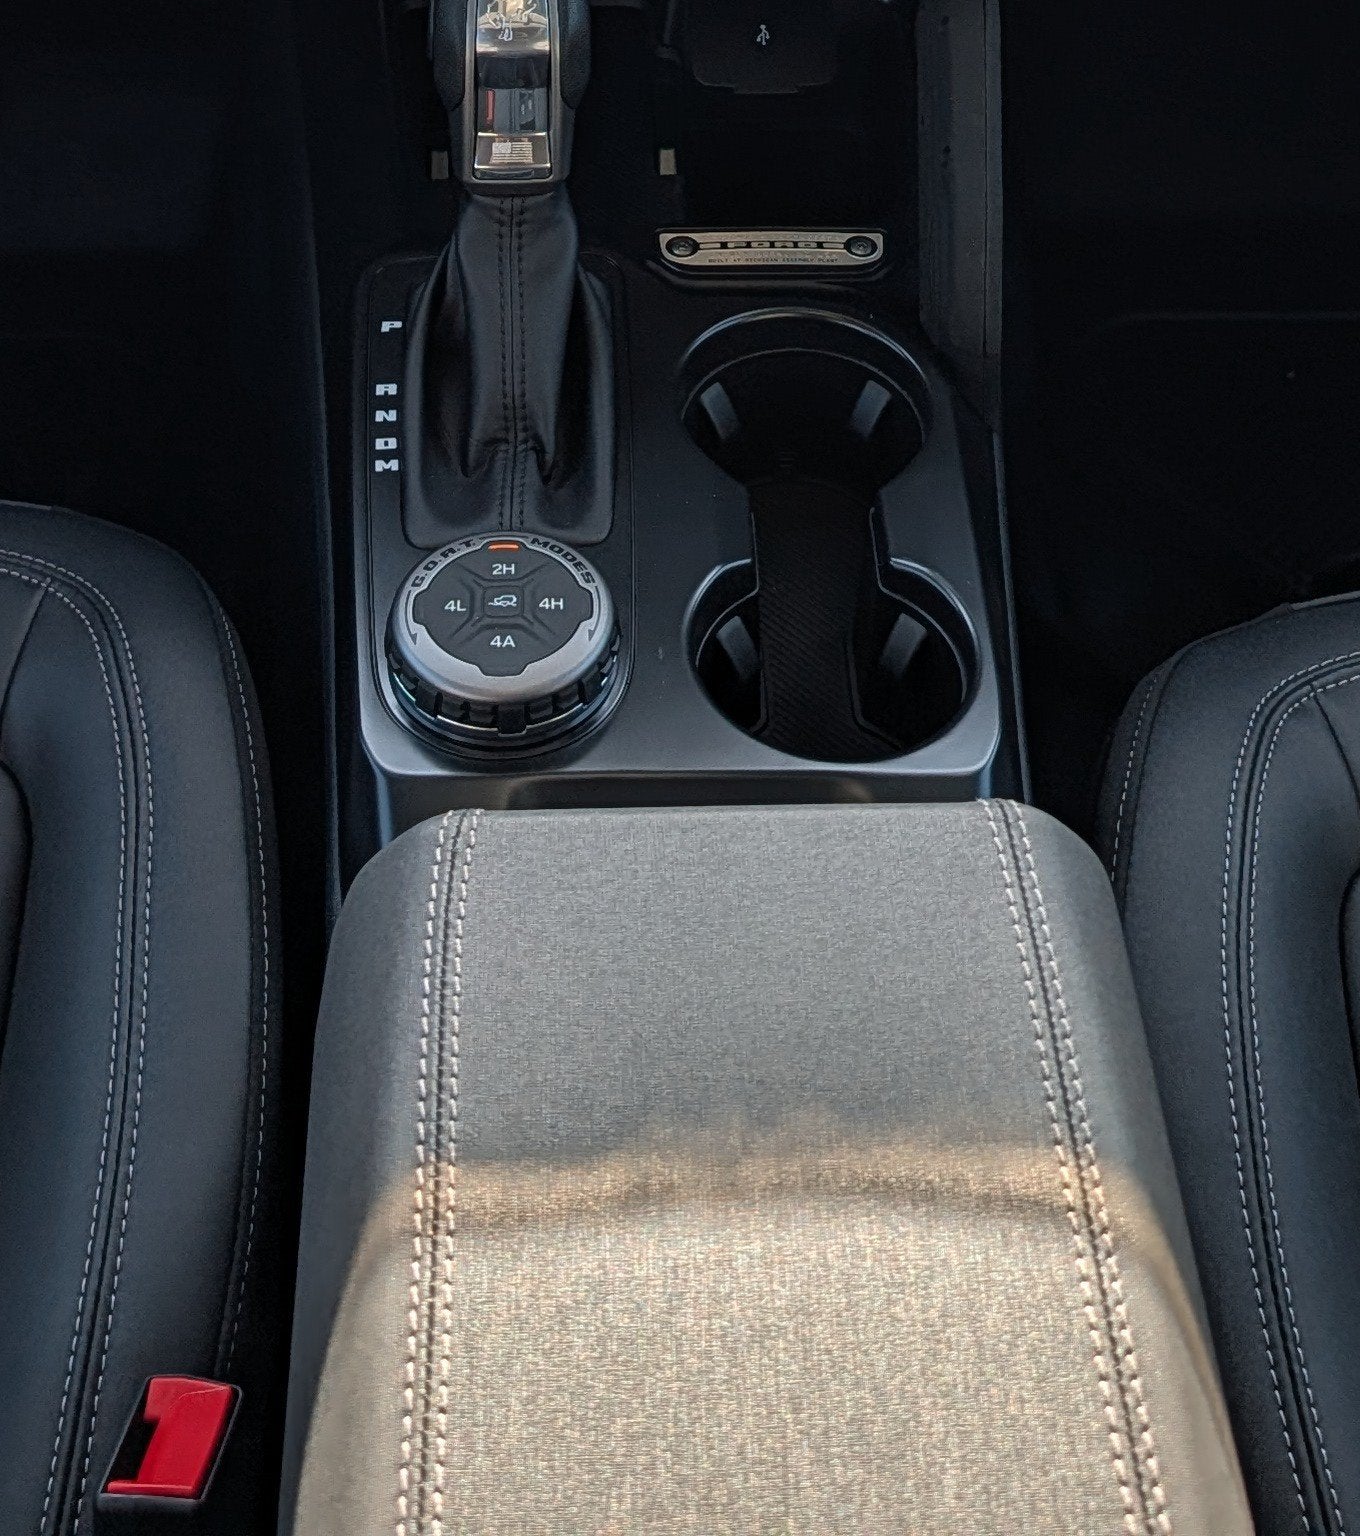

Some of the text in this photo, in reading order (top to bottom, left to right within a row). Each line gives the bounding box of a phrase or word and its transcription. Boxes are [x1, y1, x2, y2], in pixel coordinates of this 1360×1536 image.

[381, 320, 402, 333] P
[375, 409, 397, 422] N
[375, 459, 400, 473] M
[530, 537, 595, 584] MODES
[492, 563, 516, 576] 2H
[444, 599, 467, 612] 4L
[538, 597, 564, 610] 4H
[489, 635, 516, 648] 4A
